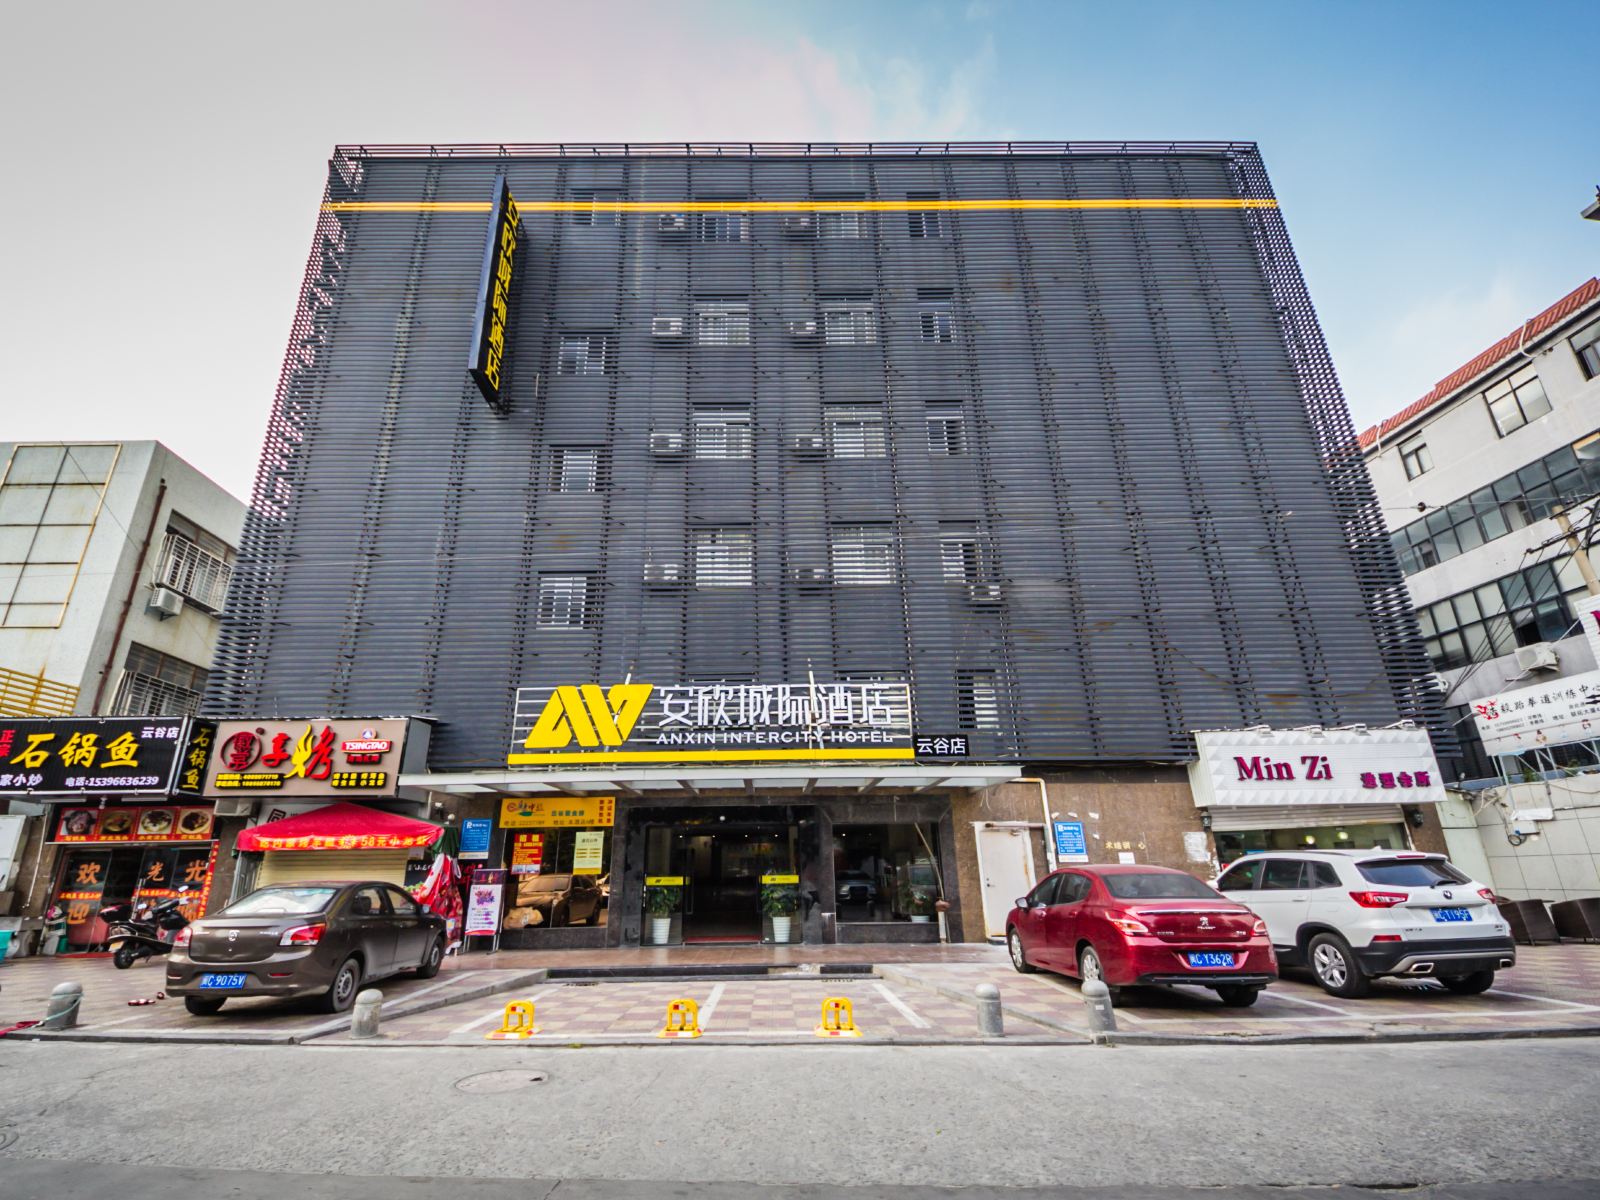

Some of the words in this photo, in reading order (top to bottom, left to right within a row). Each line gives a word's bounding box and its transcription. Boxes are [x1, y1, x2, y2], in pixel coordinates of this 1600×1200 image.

[659, 683, 892, 728] 安欣城际酒店
[141, 726, 180, 739] 云谷店
[656, 732, 716, 745] ANXIN
[724, 731, 823, 744] INTERCITY
[831, 730, 894, 744] HOTEL
[9, 731, 141, 769] 石锅鱼
[344, 741, 389, 751] TSINGTAO
[916, 737, 967, 755] 云谷店
[181, 727, 212, 790] 石锅鱼
[1233, 756, 1295, 781] Min
[1301, 756, 1333, 781] Zi
[1360, 771, 1431, 789] 造型会所
